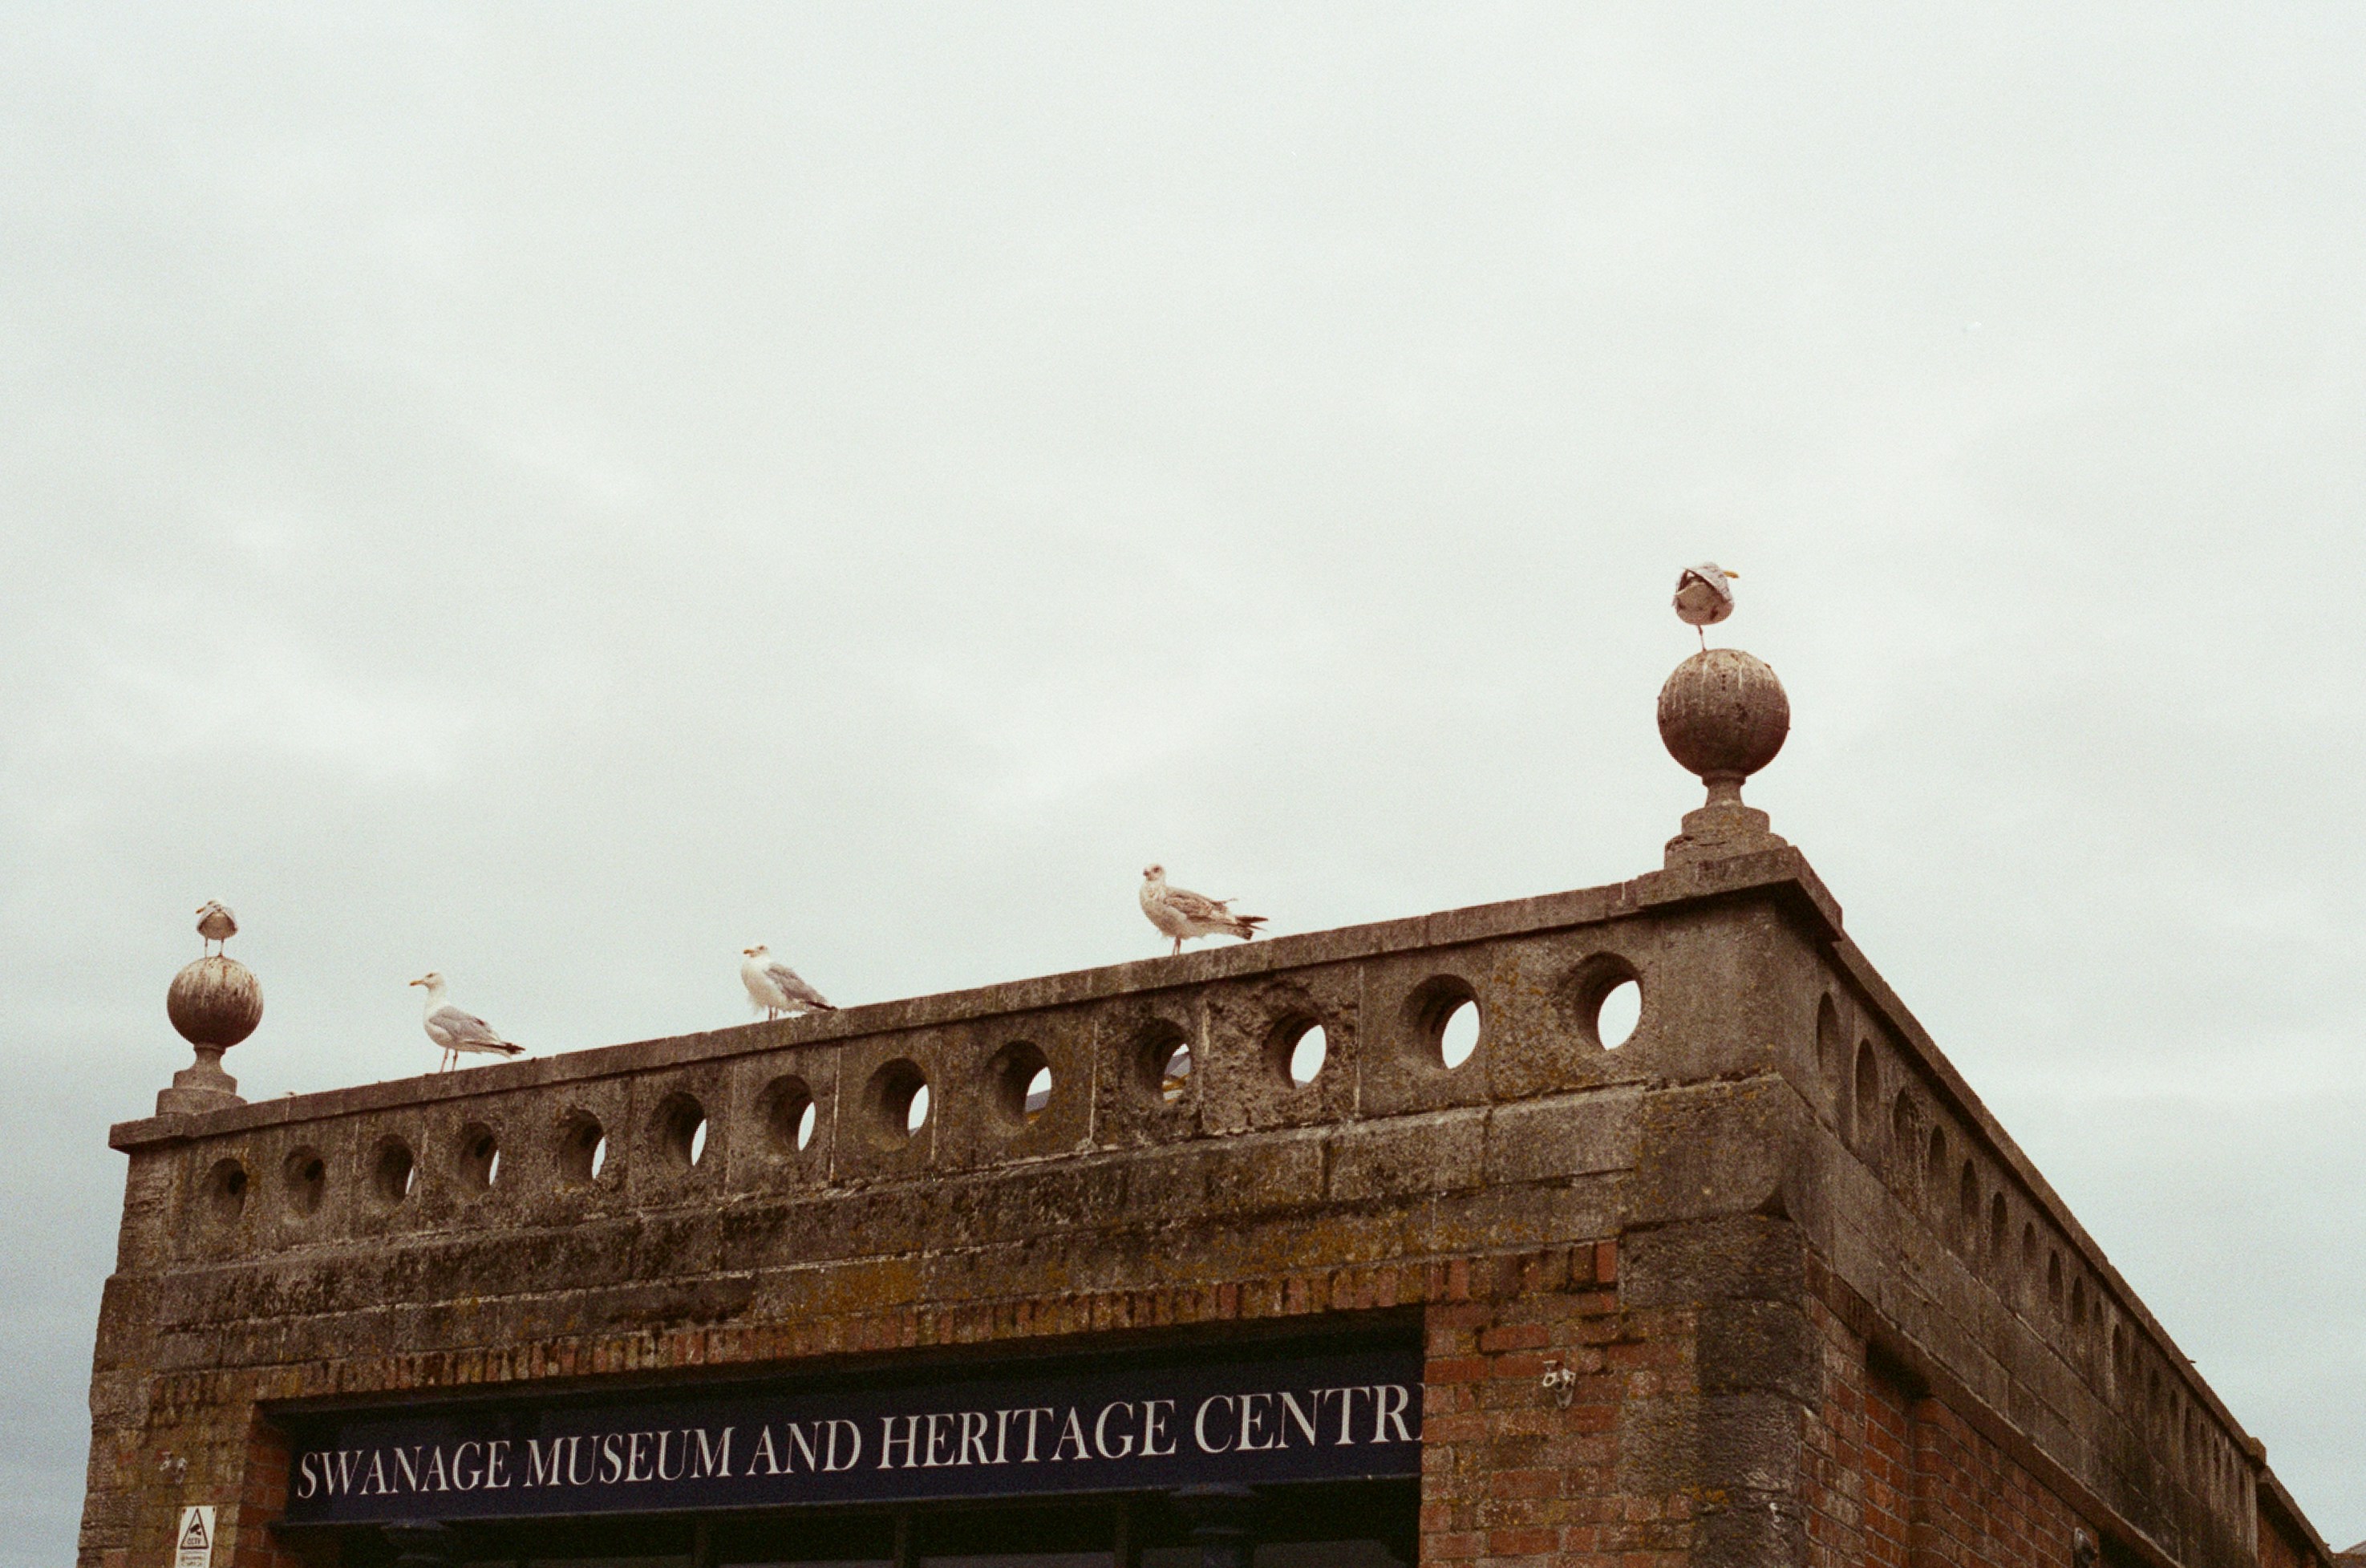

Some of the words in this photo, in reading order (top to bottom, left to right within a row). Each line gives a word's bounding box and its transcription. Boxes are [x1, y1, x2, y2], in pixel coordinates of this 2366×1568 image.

[297, 1440, 512, 1499] SWANAGE
[523, 1425, 735, 1487] MUSEUM
[745, 1419, 861, 1476] AND
[876, 1399, 1177, 1470] HERITAGE
[1193, 1382, 1426, 1453] CENTR
